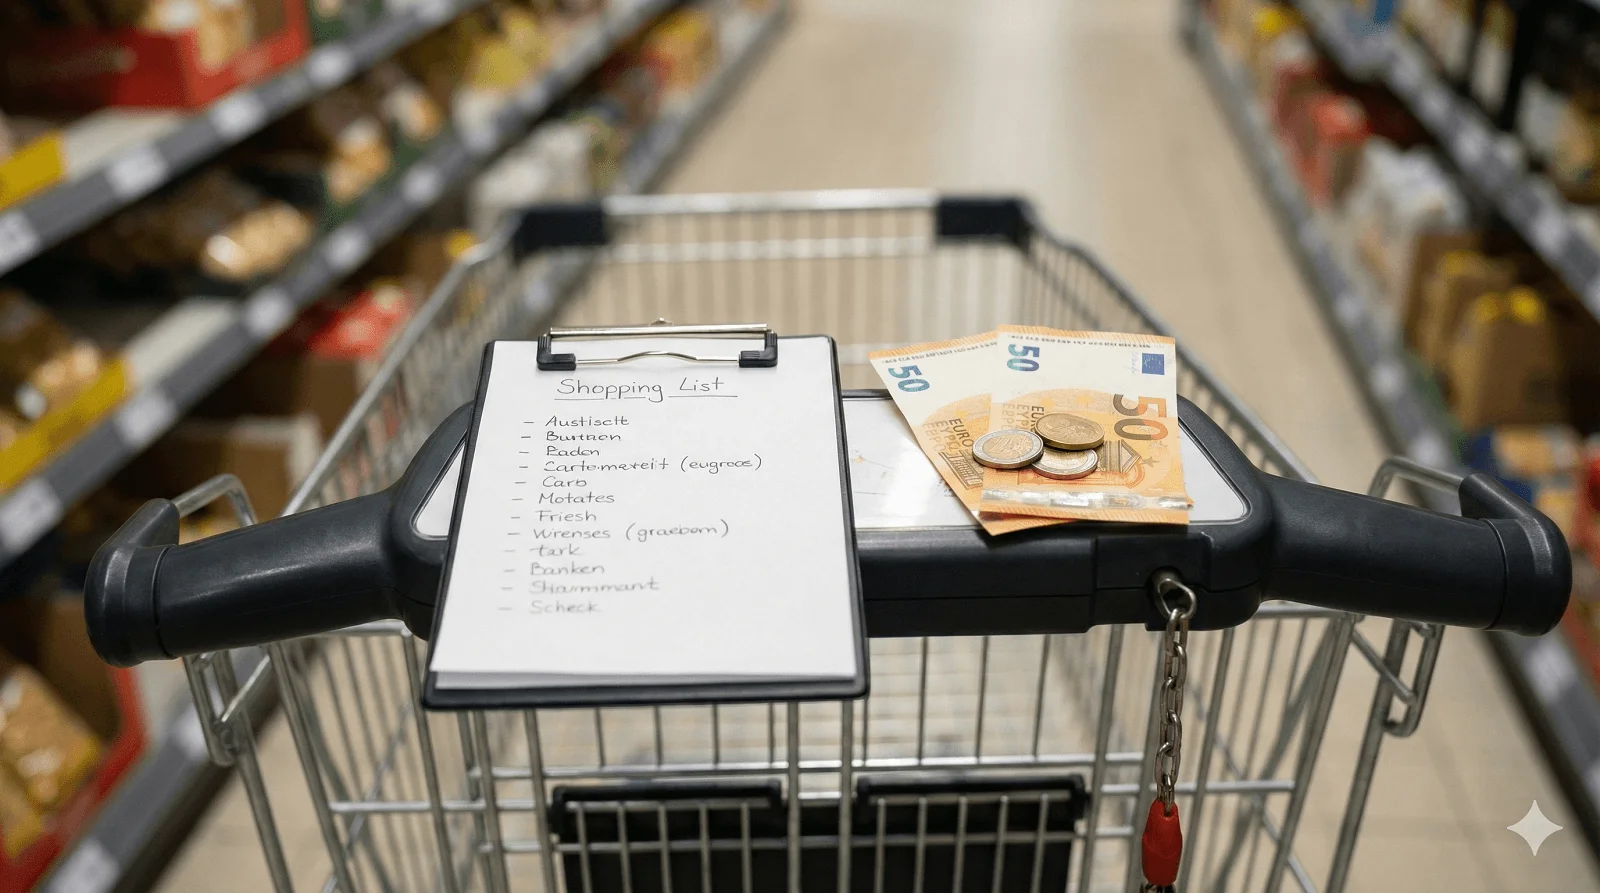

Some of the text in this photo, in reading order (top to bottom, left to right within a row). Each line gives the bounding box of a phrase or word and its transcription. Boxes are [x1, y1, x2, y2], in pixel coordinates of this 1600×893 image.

[1006, 343, 1041, 372] 50
[555, 375, 725, 404] Shopping List
[887, 364, 931, 393] 50
[1112, 393, 1169, 441] 50
[948, 418, 975, 447] EURO
[538, 490, 616, 505] Motates
[534, 510, 597, 523] Friesh
[530, 560, 605, 576] Banken
